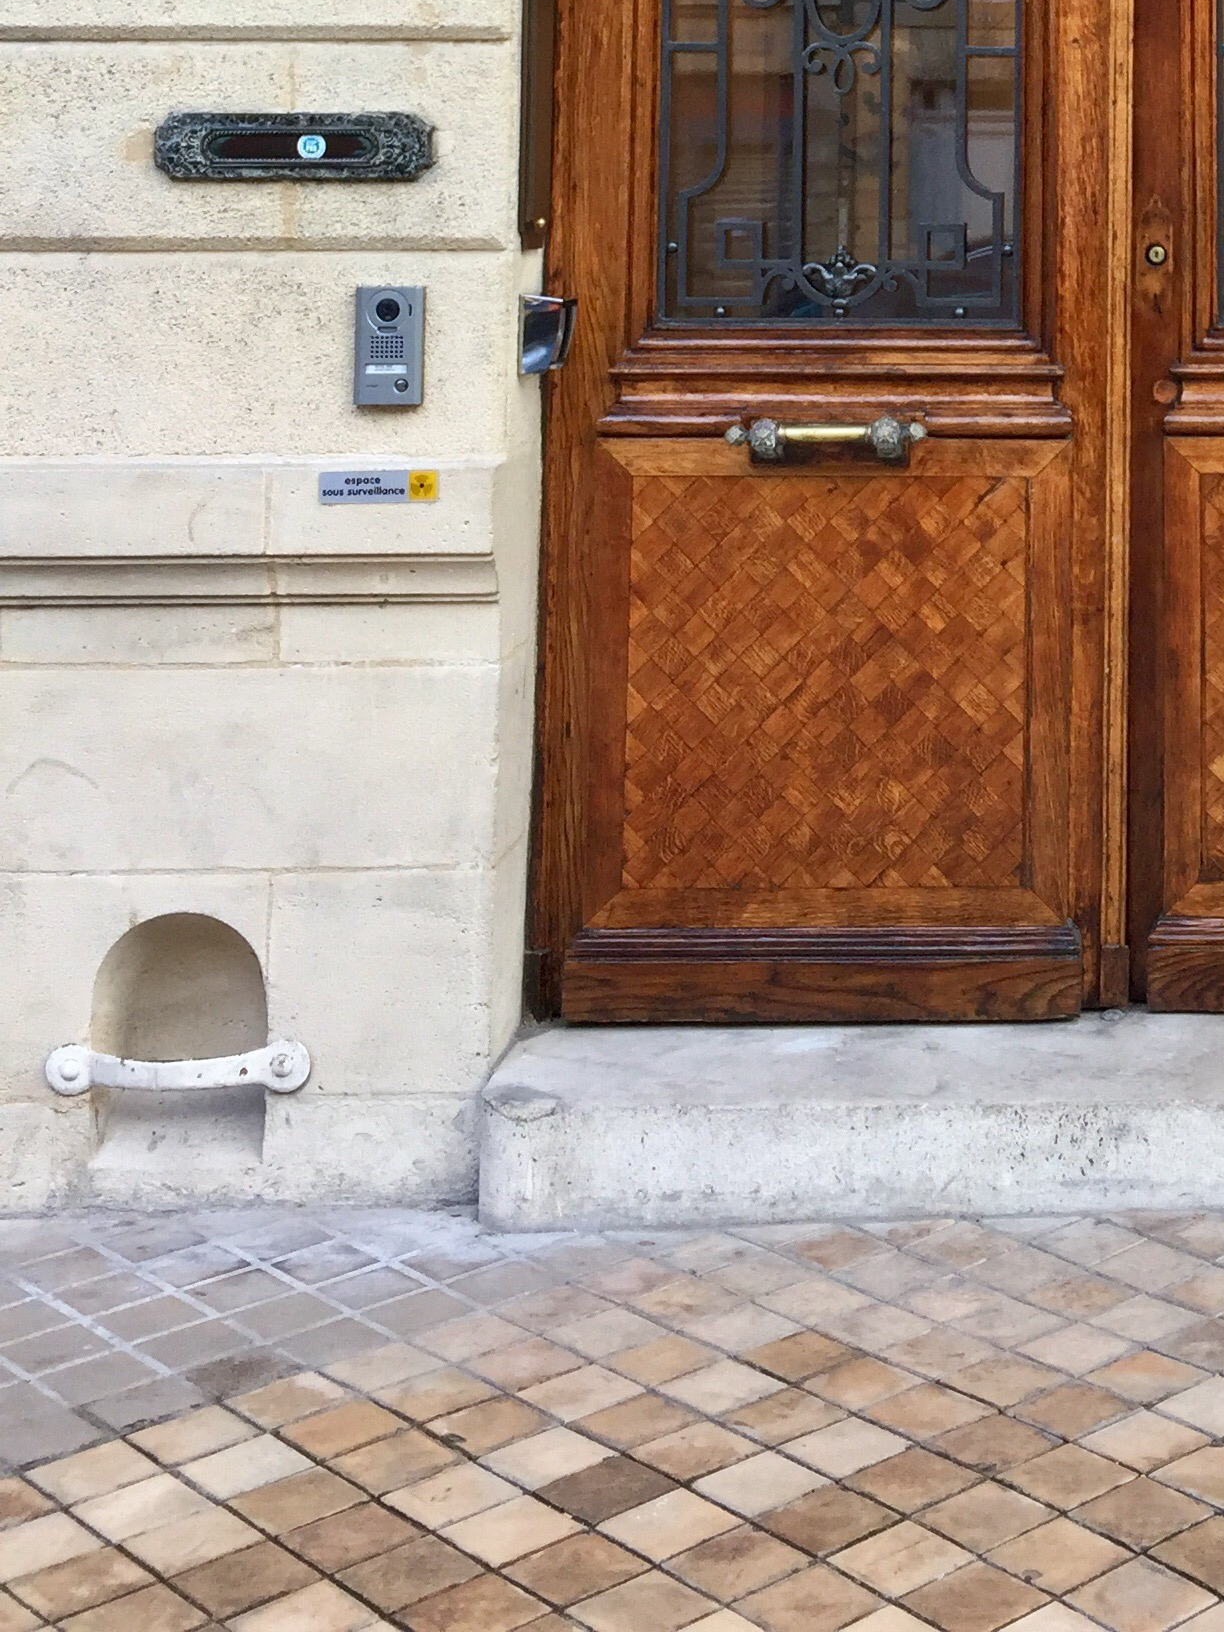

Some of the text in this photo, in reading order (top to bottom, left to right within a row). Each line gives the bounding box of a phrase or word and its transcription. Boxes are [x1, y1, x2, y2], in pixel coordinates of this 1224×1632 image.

[344, 477, 381, 486] espace
[322, 487, 406, 497] sous surveillance
